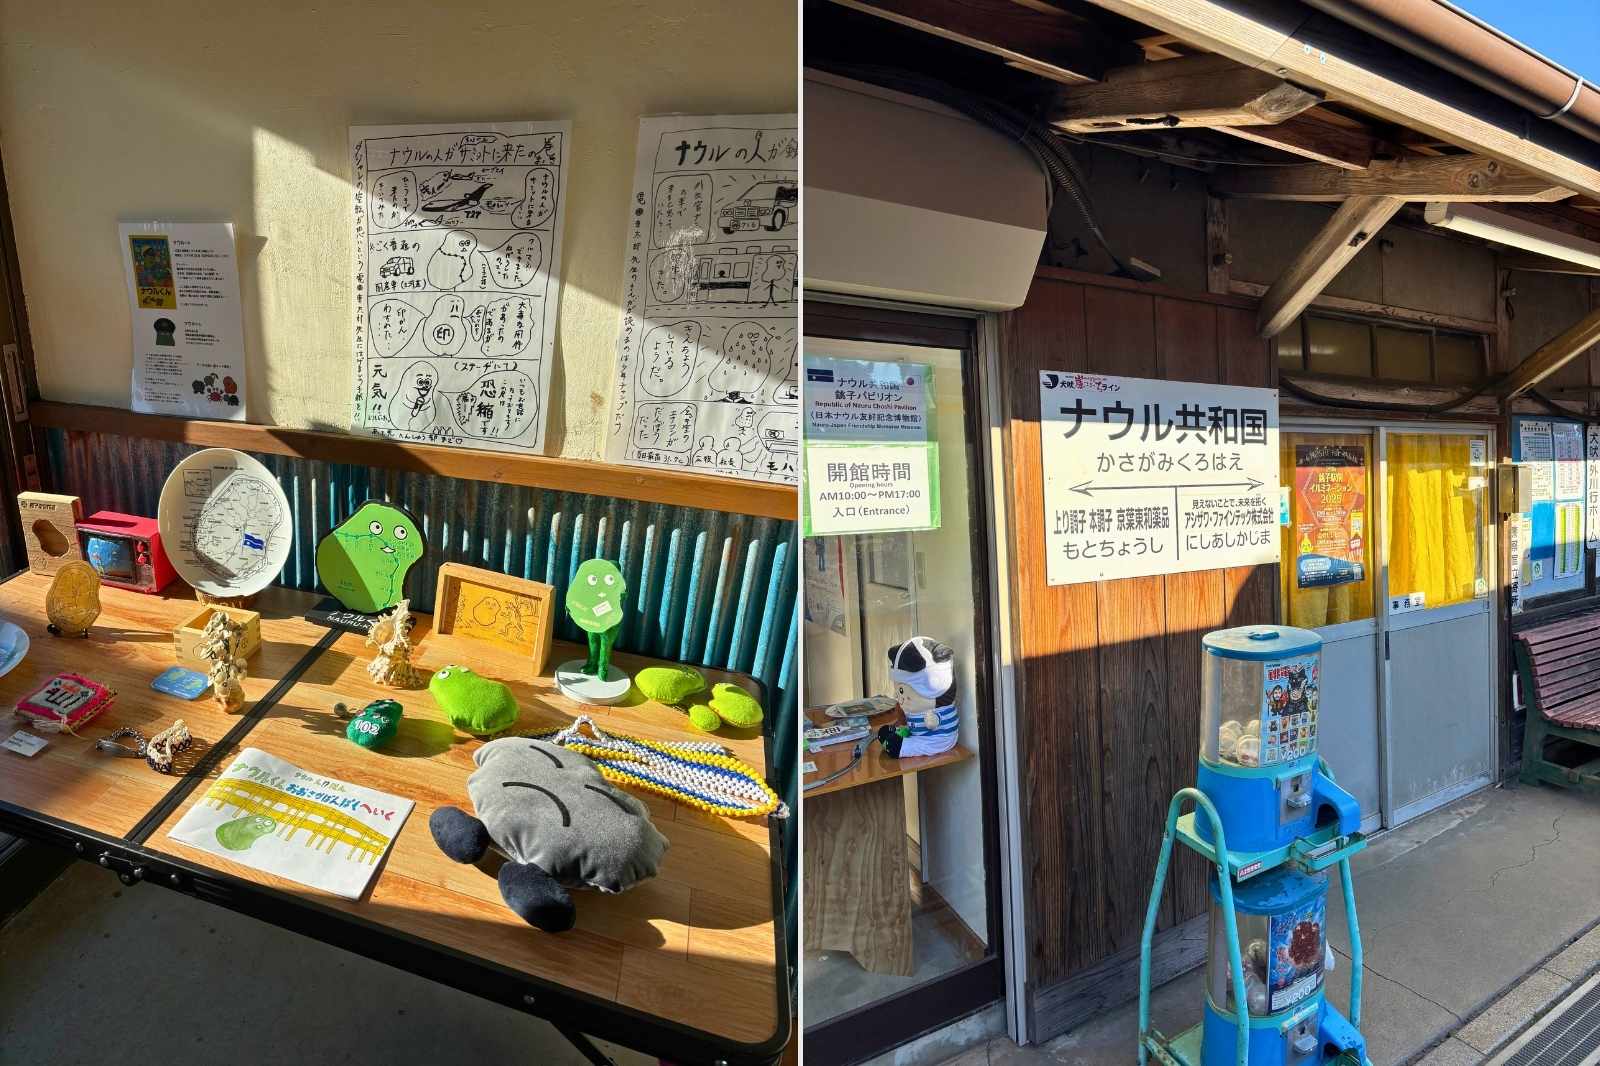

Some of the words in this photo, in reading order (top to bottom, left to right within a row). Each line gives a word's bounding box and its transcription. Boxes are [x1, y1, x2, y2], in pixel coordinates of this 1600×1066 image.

[815, 400, 843, 409] Republic
[835, 390, 903, 402] 銚子パビリオン
[1060, 398, 1268, 445] ナウル共和国
[828, 463, 911, 482] 開館時間
[1097, 452, 1244, 473] かさがみくろはえ
[1054, 509, 1086, 535] 上り調子
[1089, 508, 1113, 532] 本調子
[1116, 506, 1170, 531] 京葉東和薬品
[1063, 537, 1164, 560] もとちょうし
[1186, 530, 1271, 551] にしあしかじま
[326, 615, 371, 629] NAURU-K
